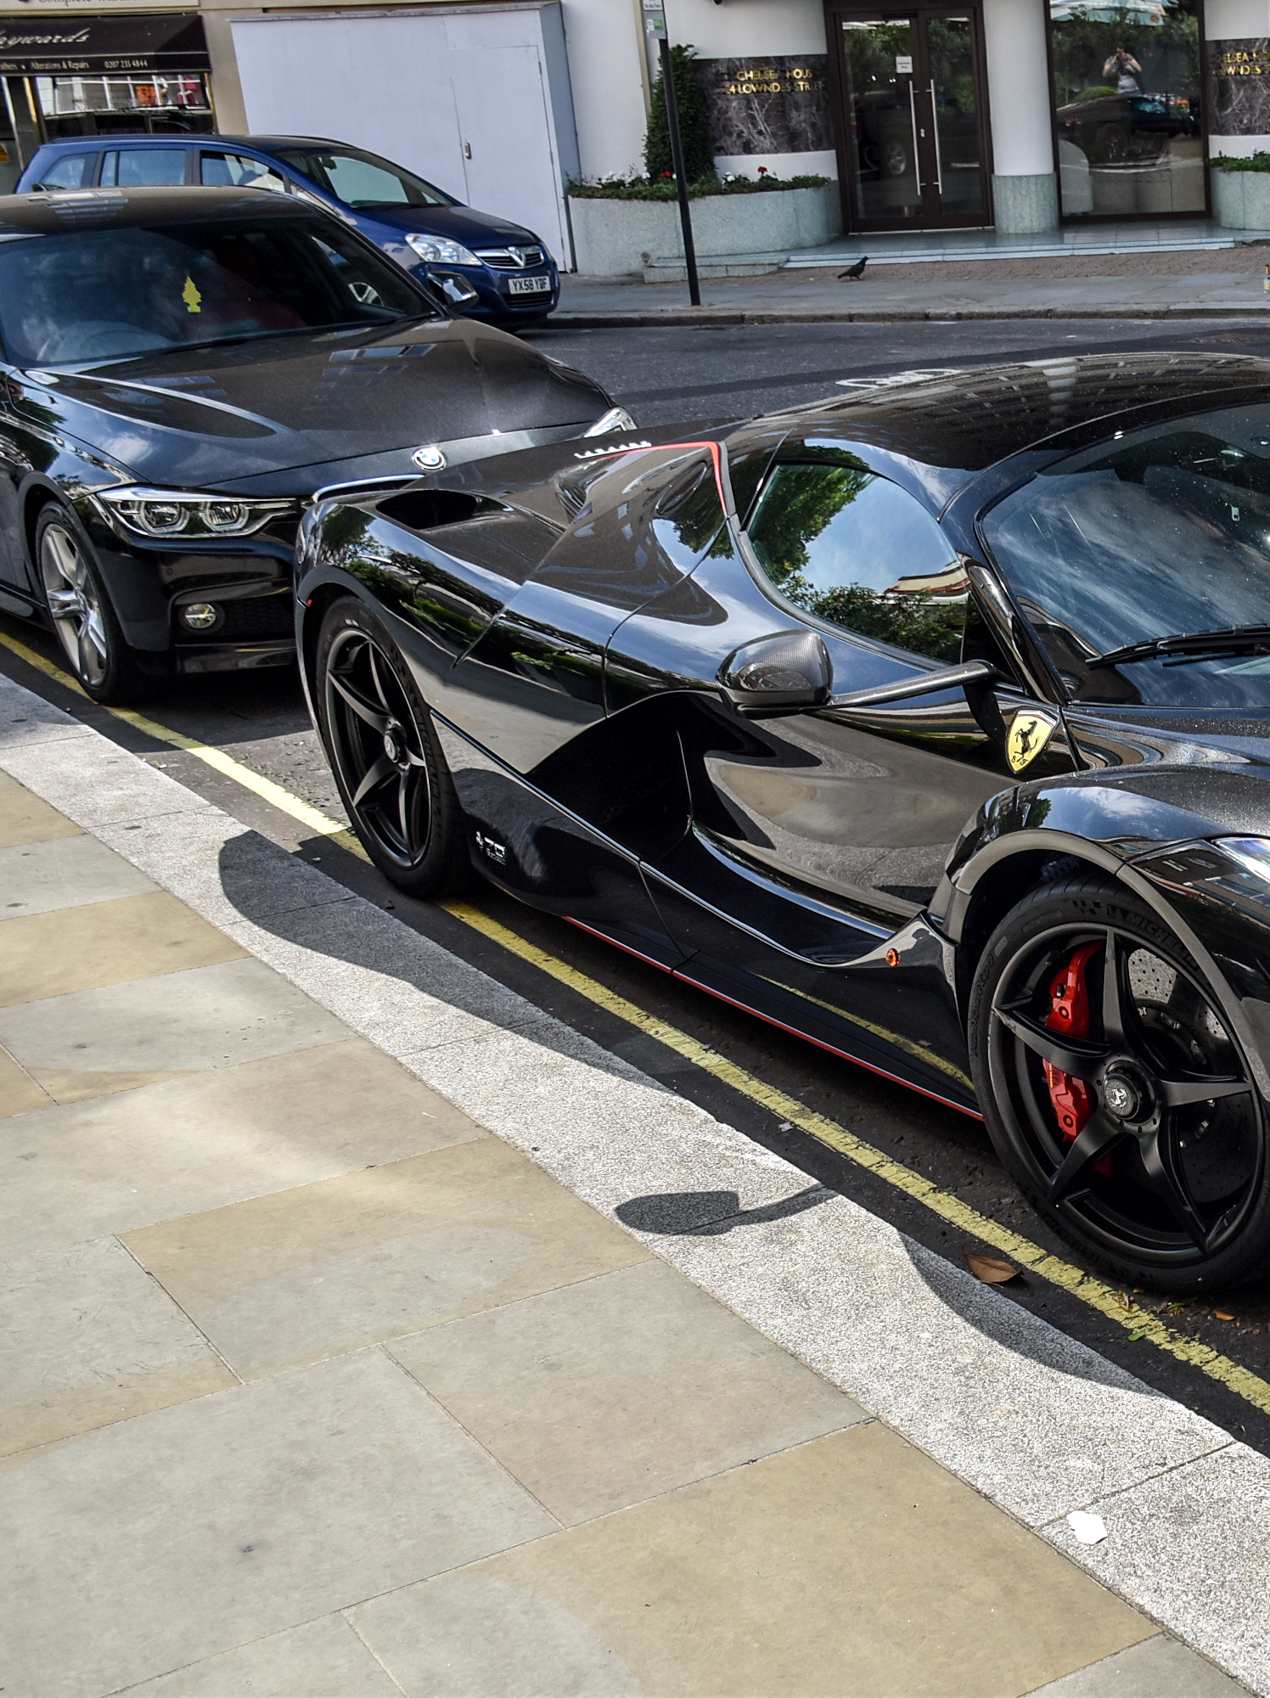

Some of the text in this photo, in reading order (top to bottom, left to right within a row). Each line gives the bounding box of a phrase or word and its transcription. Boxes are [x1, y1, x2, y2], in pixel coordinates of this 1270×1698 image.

[0, 27, 91, 49] aywards
[67, 61, 90, 71] Repairs
[104, 60, 119, 69] 0207
[737, 82, 791, 94] LOWNDES
